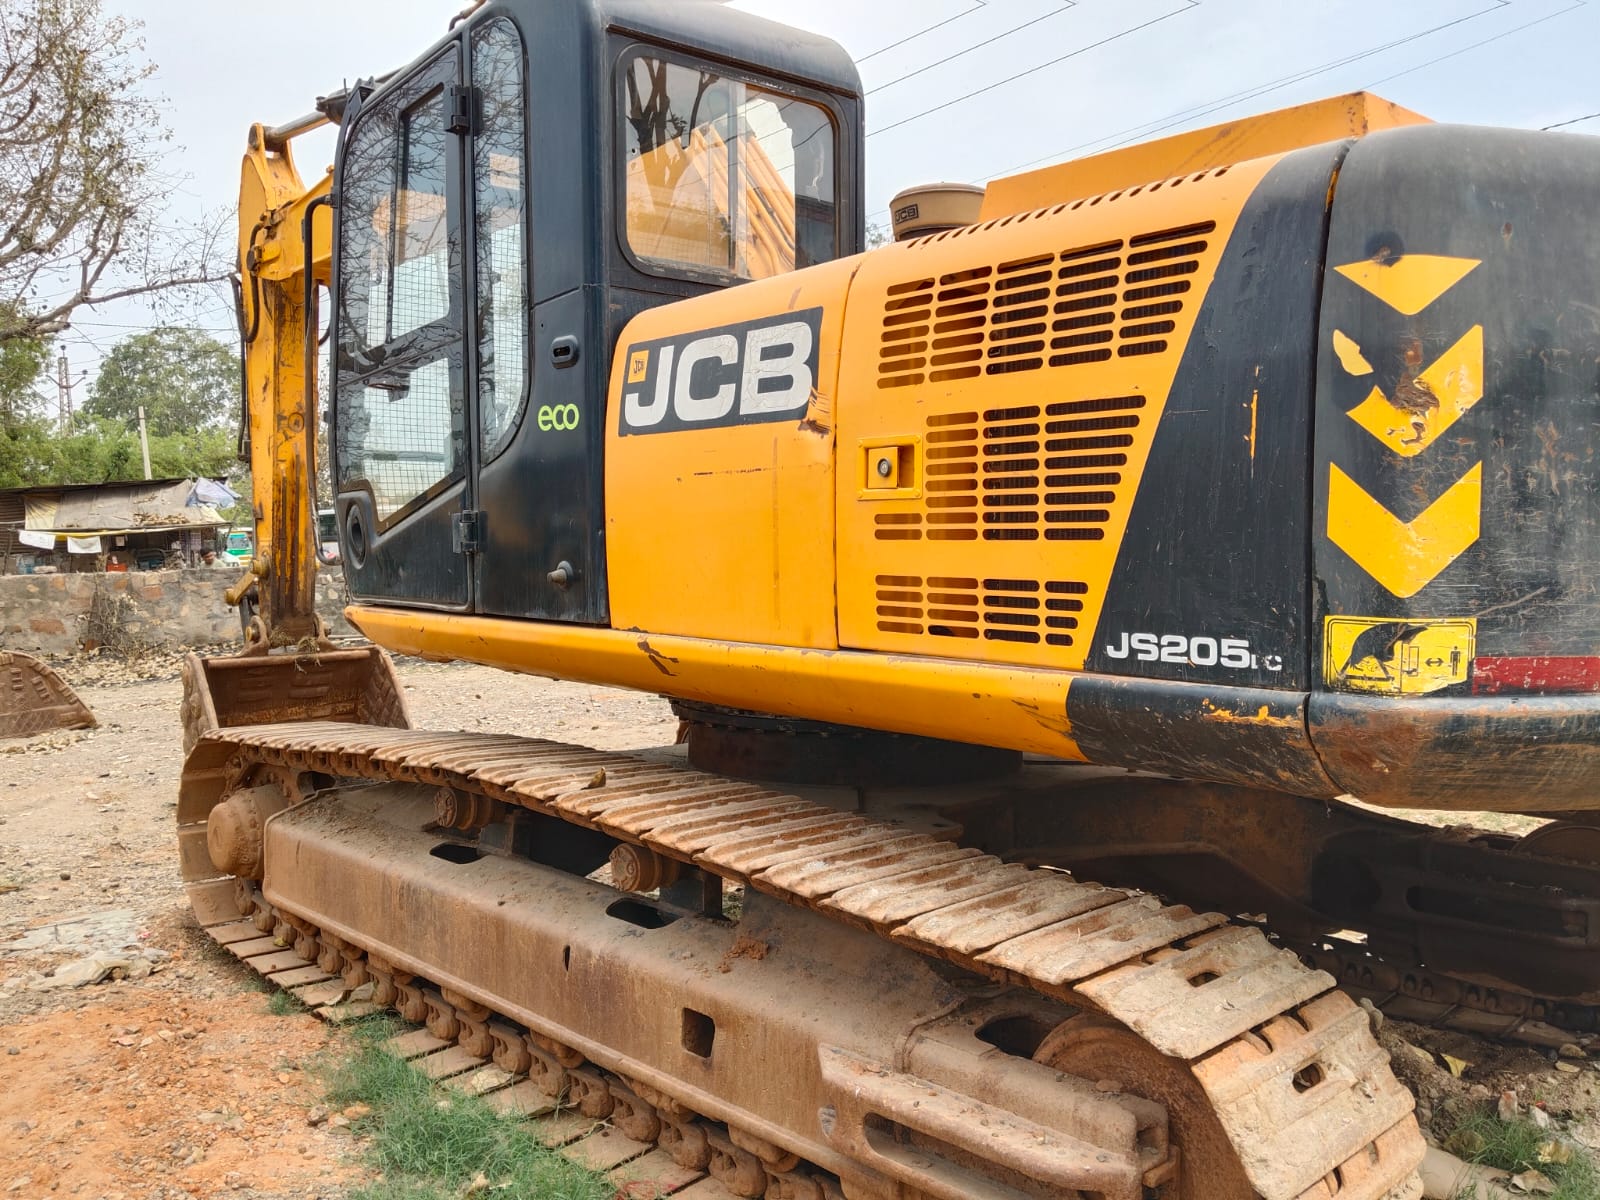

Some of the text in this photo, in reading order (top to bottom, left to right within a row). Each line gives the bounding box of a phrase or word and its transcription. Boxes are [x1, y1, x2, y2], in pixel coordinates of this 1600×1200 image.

[895, 206, 917, 223] JCB
[625, 321, 813, 427] JCB
[538, 403, 580, 431] eco
